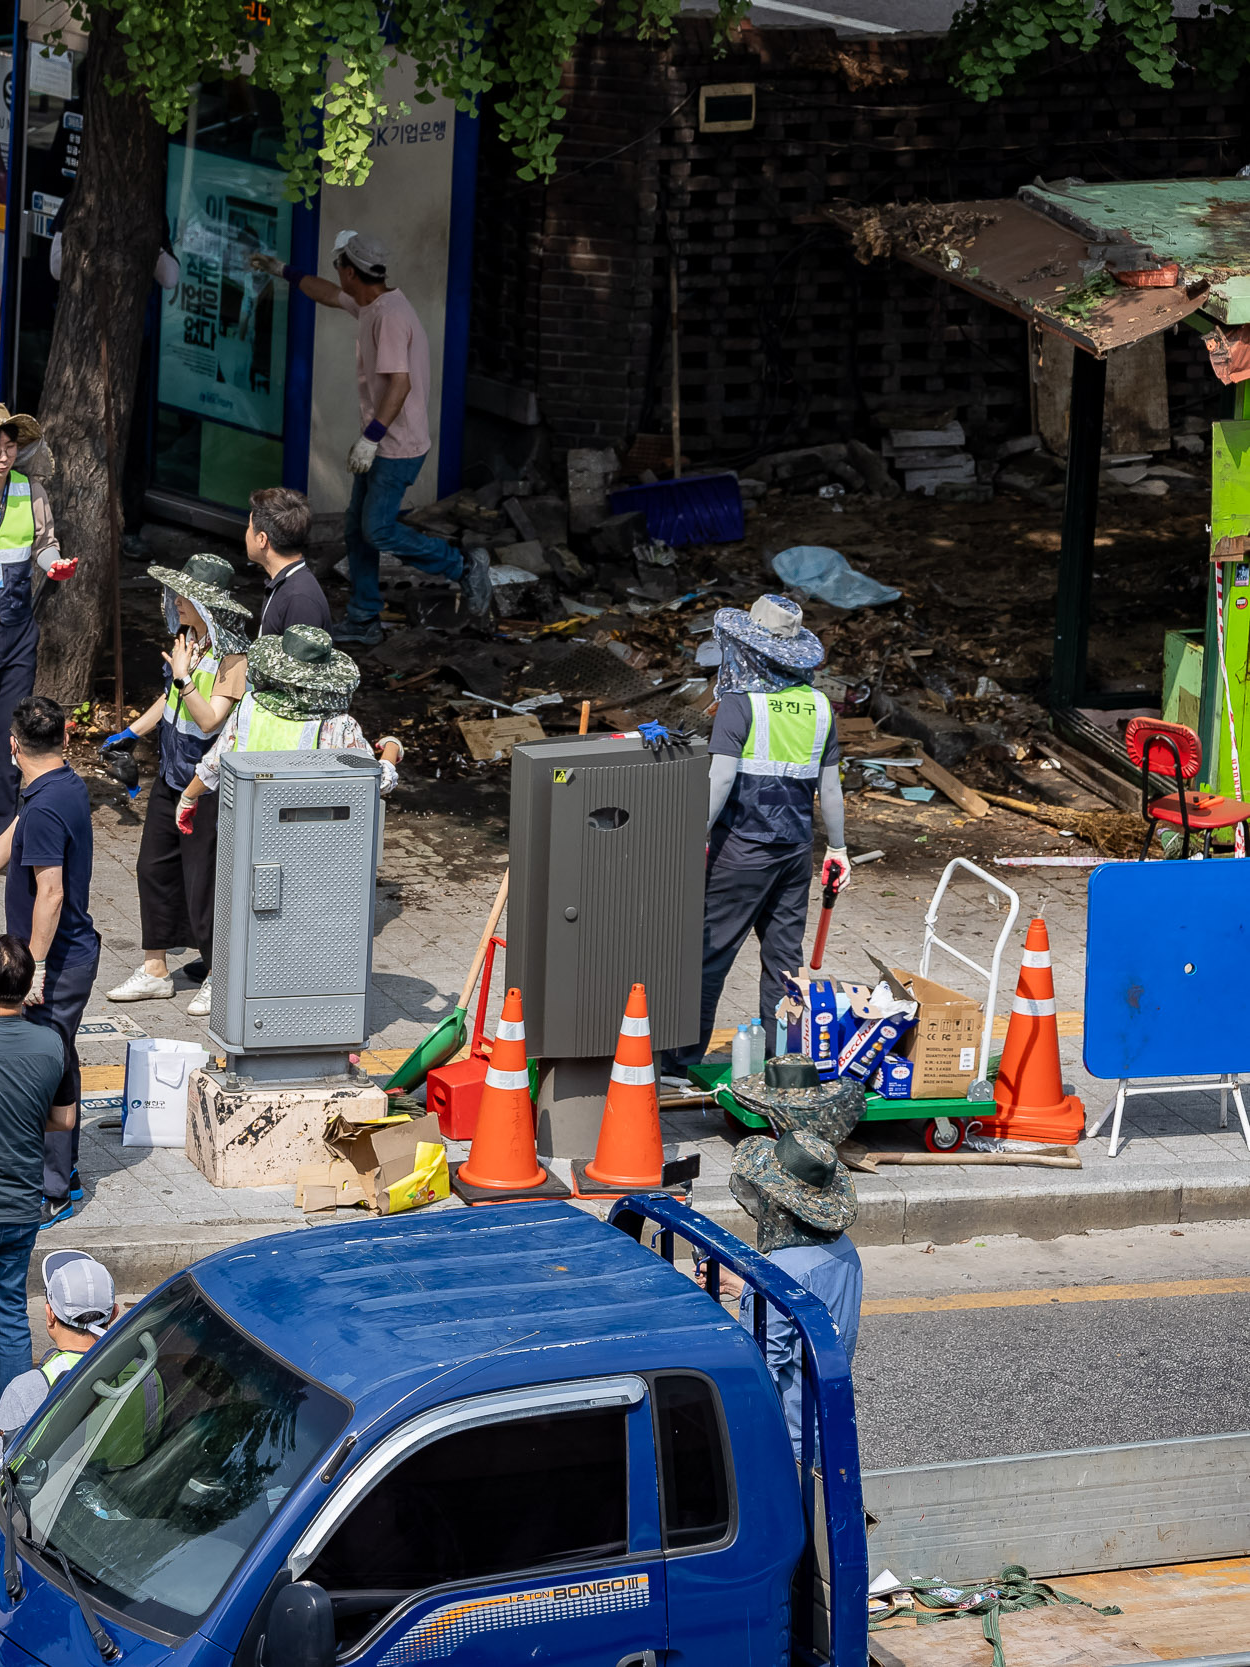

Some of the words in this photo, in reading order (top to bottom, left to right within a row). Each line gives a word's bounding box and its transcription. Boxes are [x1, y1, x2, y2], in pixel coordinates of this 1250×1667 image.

[391, 120, 447, 145] 기업은행
[768, 699, 817, 716] 광진구
[838, 1019, 878, 1068] Bacchus
[509, 1594, 525, 1604] 1.2
[527, 1590, 550, 1600] TON
[553, 1579, 626, 1601] BONGO
